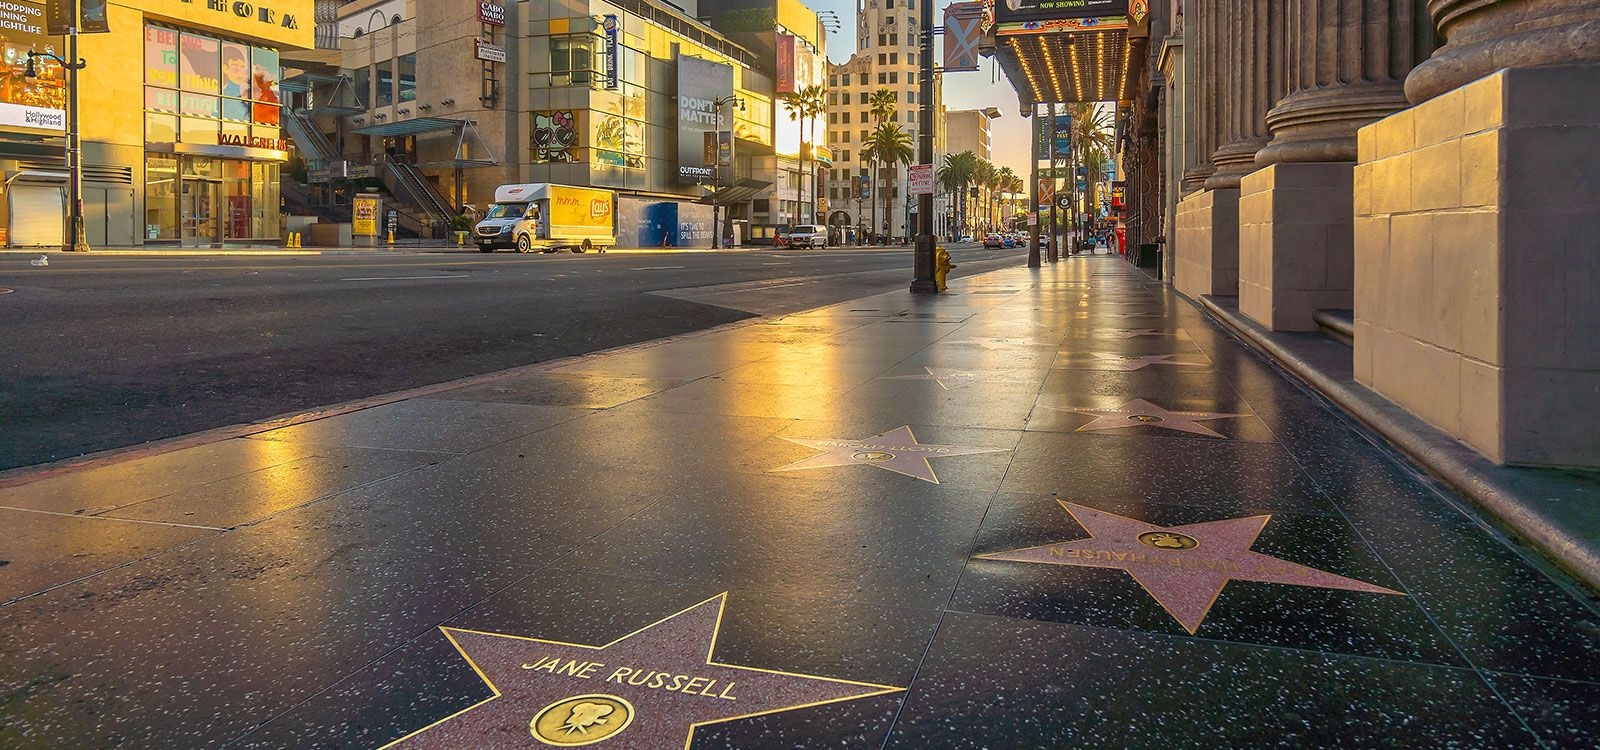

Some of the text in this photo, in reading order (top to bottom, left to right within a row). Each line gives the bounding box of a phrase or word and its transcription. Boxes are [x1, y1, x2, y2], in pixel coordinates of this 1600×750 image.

[481, 2, 505, 14] CABO
[1055, 0, 1085, 8] SHOWING
[481, 9, 505, 20] WABO
[680, 95, 714, 113] DON'T
[25, 110, 62, 120] Hollywood
[680, 108, 724, 126] MATTER
[217, 133, 287, 151] WALGREENS
[680, 166, 712, 176] OUTFRONT
[818, 440, 886, 450] HAROLD
[521, 656, 737, 701] JANE RUSSELL
